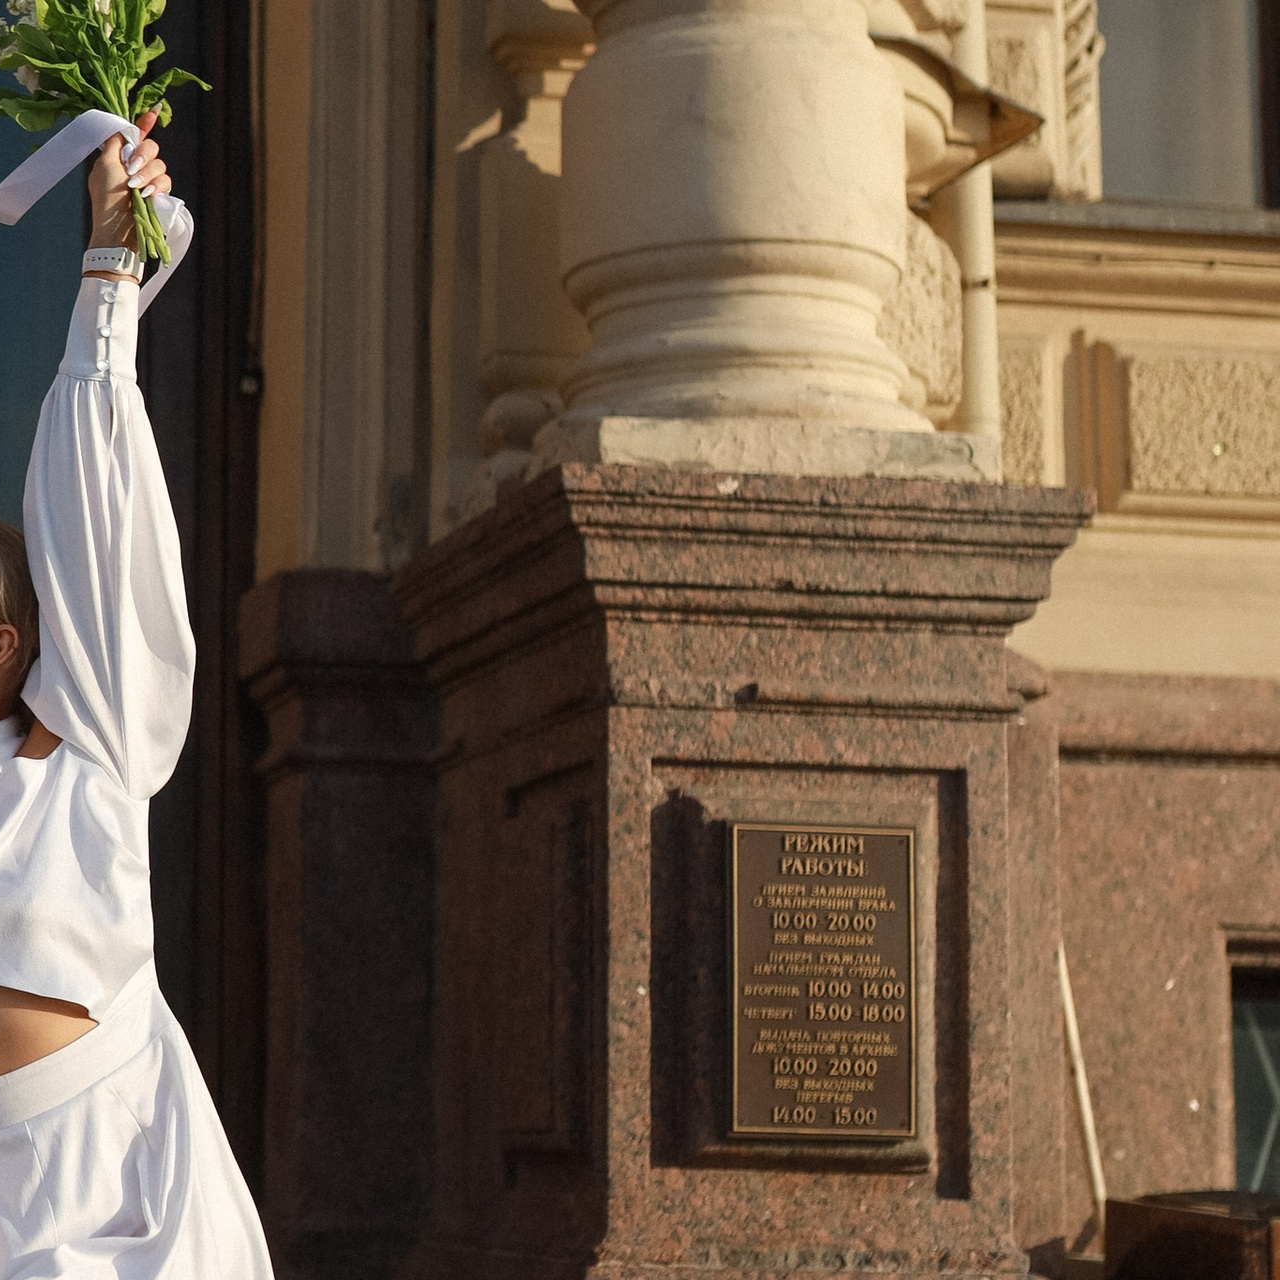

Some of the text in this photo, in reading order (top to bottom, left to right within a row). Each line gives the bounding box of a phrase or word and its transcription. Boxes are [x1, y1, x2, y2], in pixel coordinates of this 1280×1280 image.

[783, 833, 864, 855] РЕЖИМ
[753, 897, 763, 908] О
[858, 899, 896, 912] БРАКА
[772, 911, 817, 930] 10.00
[827, 912, 877, 932] 20.00
[774, 932, 875, 947] БЕЗ ВЫХОДНЫХ
[819, 952, 881, 966] ГРАЖДАН
[848, 966, 896, 979] ОТДЕЛА
[743, 983, 800, 997] ВТОРНИК
[808, 979, 852, 998] 10.00
[862, 981, 905, 1000] 14.00
[743, 1006, 797, 1020] ЧЕТВЕРГ
[808, 1002, 852, 1021] 15.00
[862, 1003, 906, 1023] 18.00
[817, 1030, 891, 1044] ПОВТОРНЫХ
[773, 1056, 878, 1077] 10.00 20.00
[774, 1077, 876, 1092] БЕЗ ВЫХОДНЫХ
[796, 1090, 854, 1104] ПЕРЕРЫВ
[772, 1104, 817, 1124] 14.00
[834, 1106, 878, 1125] 15.00
